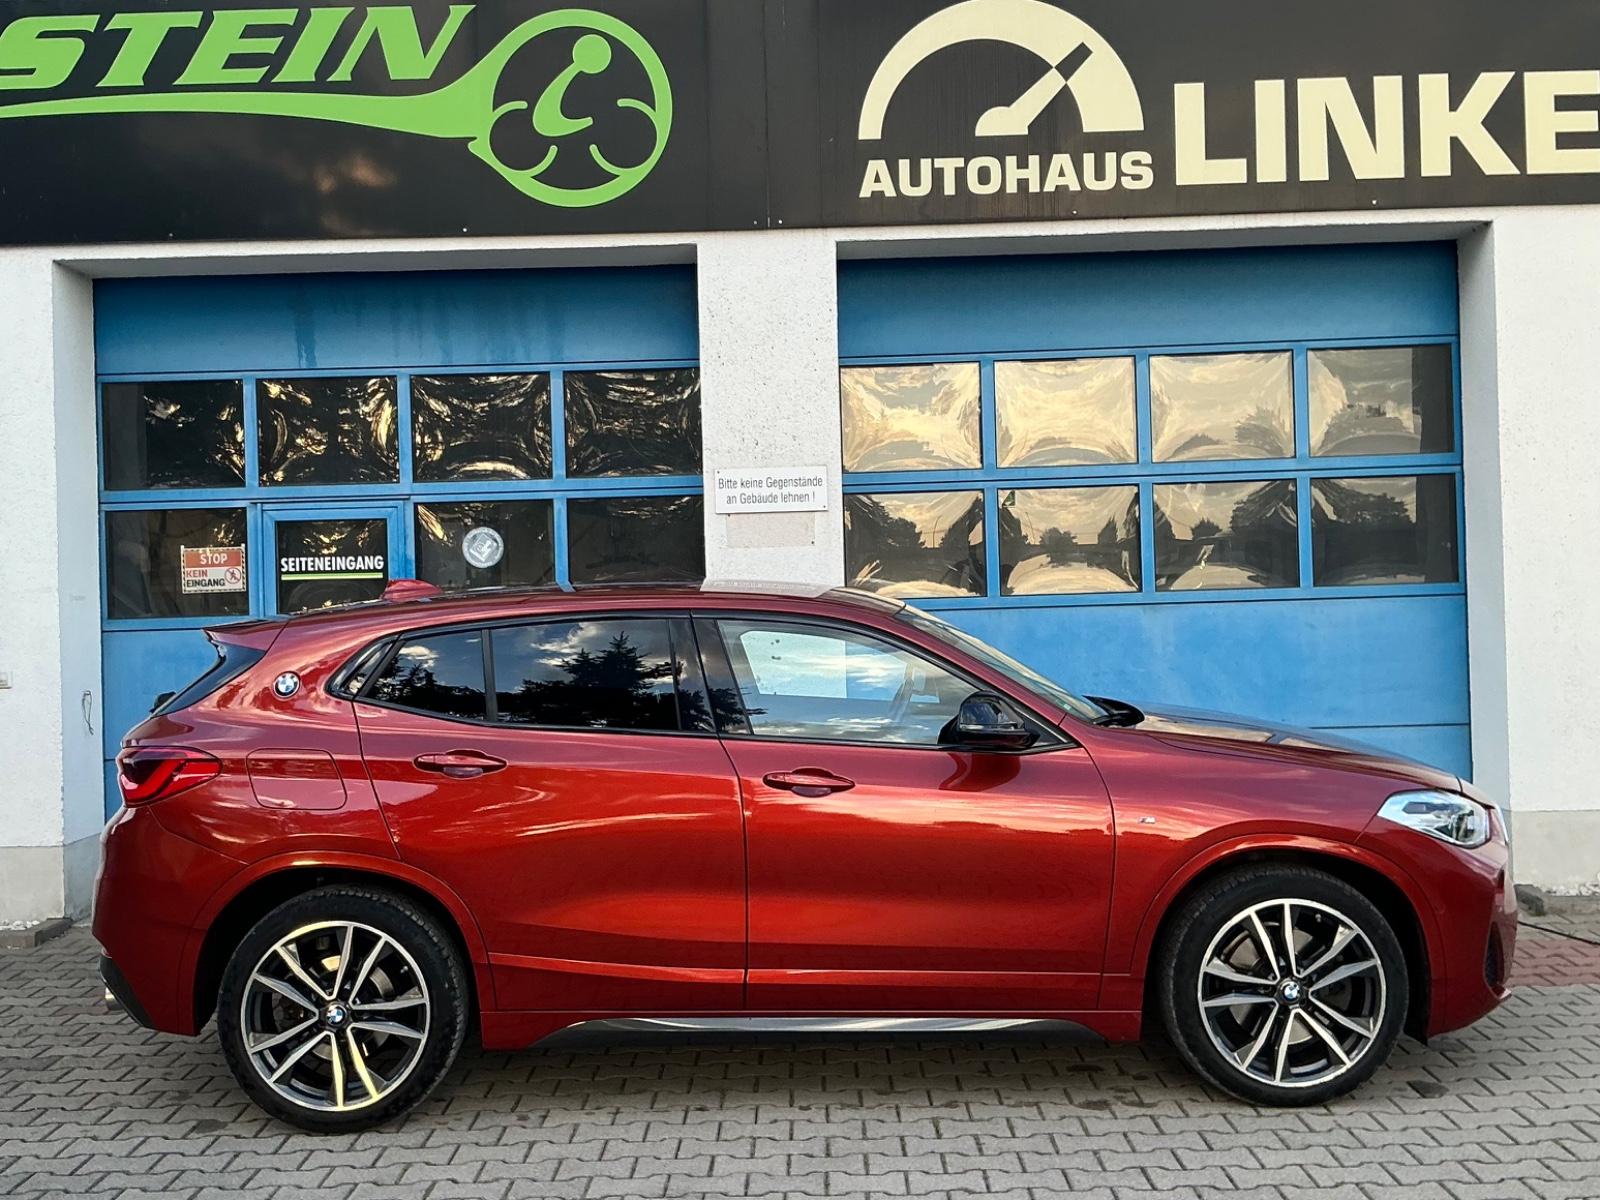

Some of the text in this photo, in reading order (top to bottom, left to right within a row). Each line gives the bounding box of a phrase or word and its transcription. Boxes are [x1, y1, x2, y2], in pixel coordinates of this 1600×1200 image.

[0, 5, 476, 90] STEIN
[859, 70, 1600, 198] AUTOHAUS LINKE
[718, 476, 823, 490] Bitte keine Gegenstände
[726, 495, 737, 504] an
[740, 492, 778, 504] Gebäude
[200, 553, 228, 564] STOP
[280, 555, 384, 572] SEITENEINGANG
[186, 569, 208, 578] KEIN
[186, 578, 225, 588] EINGANG
